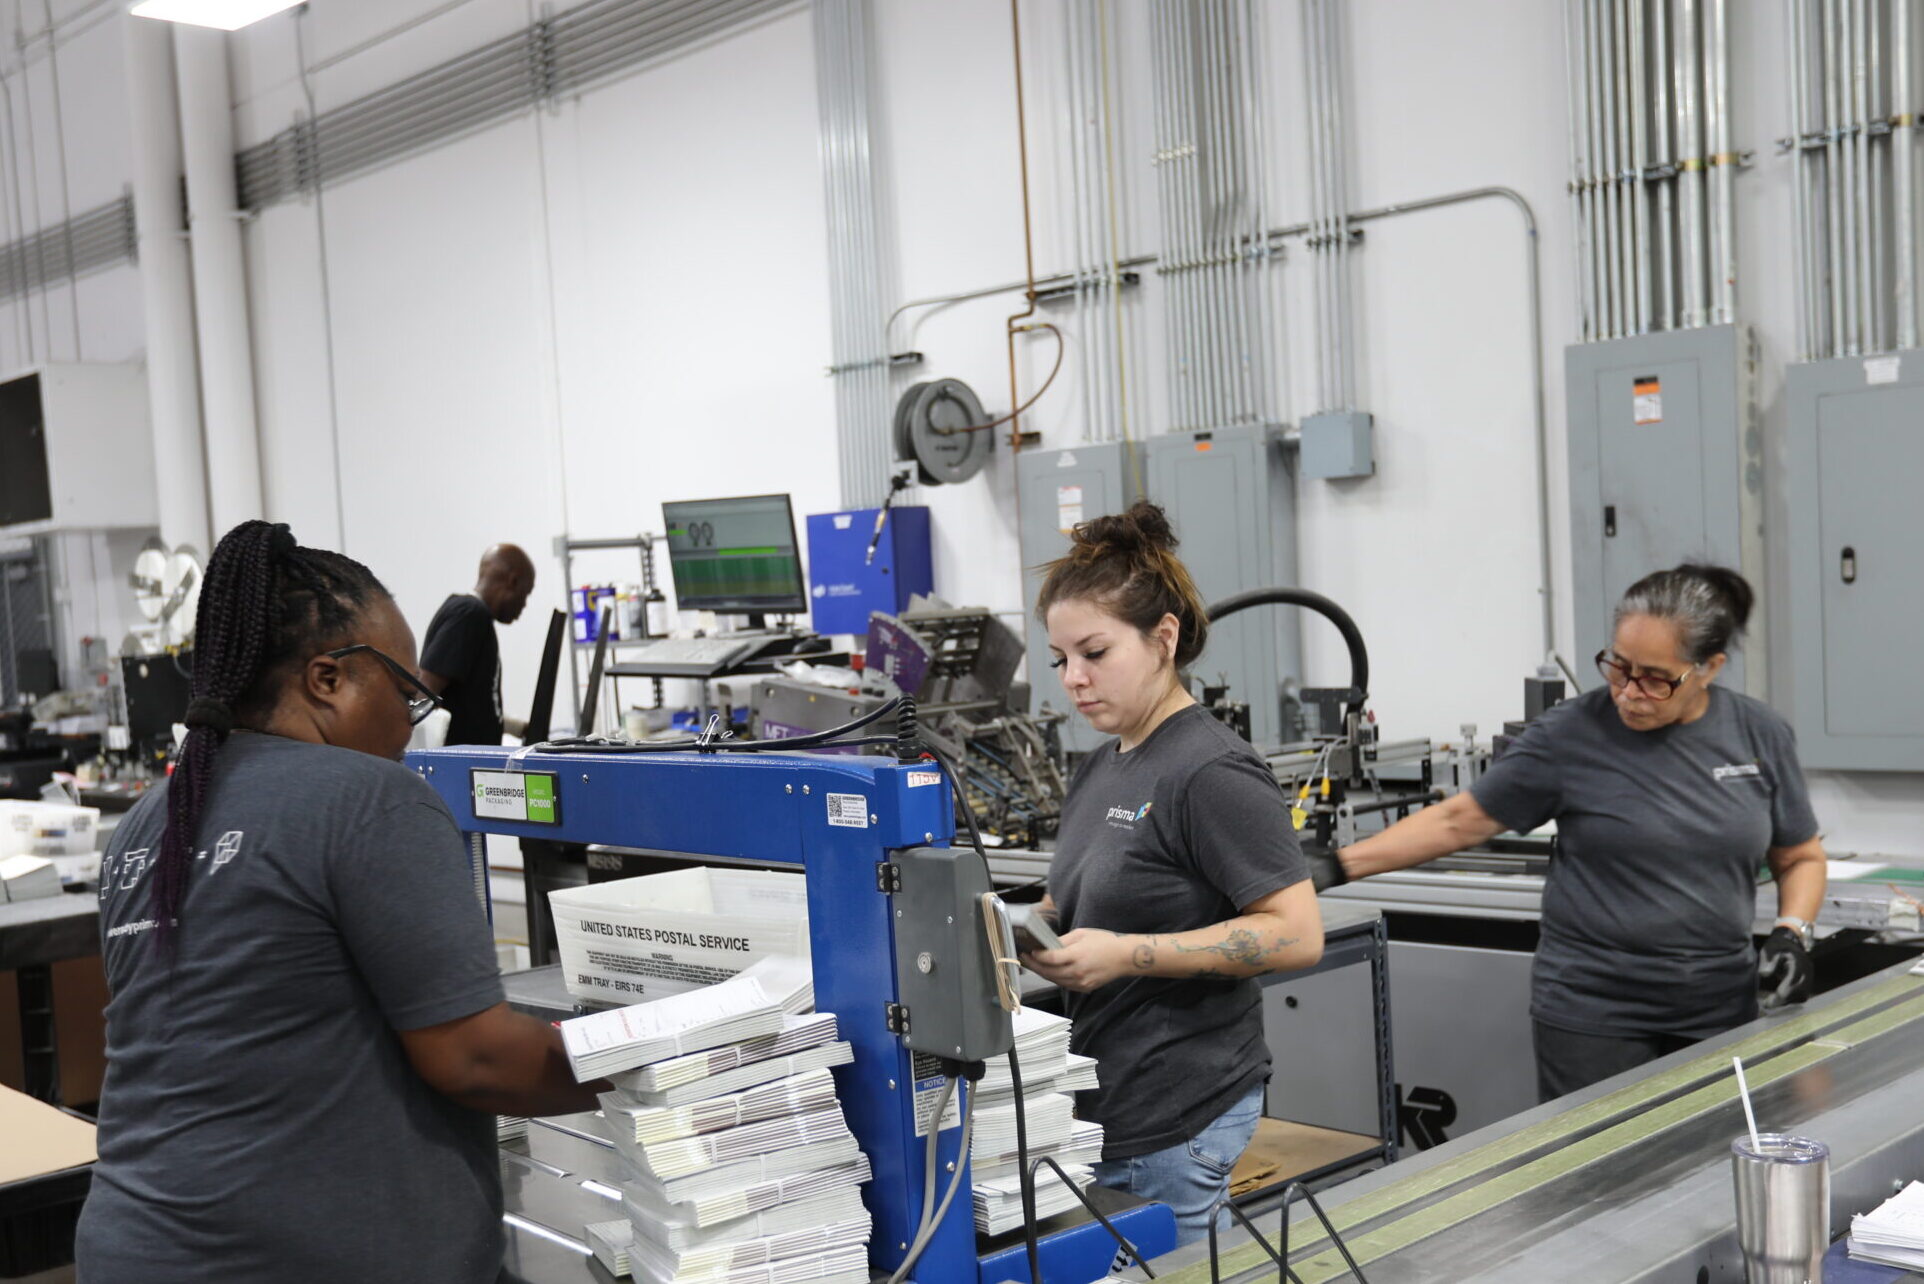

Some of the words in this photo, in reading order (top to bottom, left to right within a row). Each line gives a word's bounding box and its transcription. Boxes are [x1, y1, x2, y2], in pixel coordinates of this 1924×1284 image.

[485, 787, 524, 798] GREENBRIDGE
[1105, 805, 1135, 821] prisma
[580, 920, 613, 936] UNITED
[615, 925, 652, 941] STATES
[655, 929, 697, 947] POSTAL
[699, 934, 750, 952] SERVICE
[593, 976, 610, 988] TRAY
[615, 980, 631, 992] EIRS
[631, 983, 644, 994] 74E
